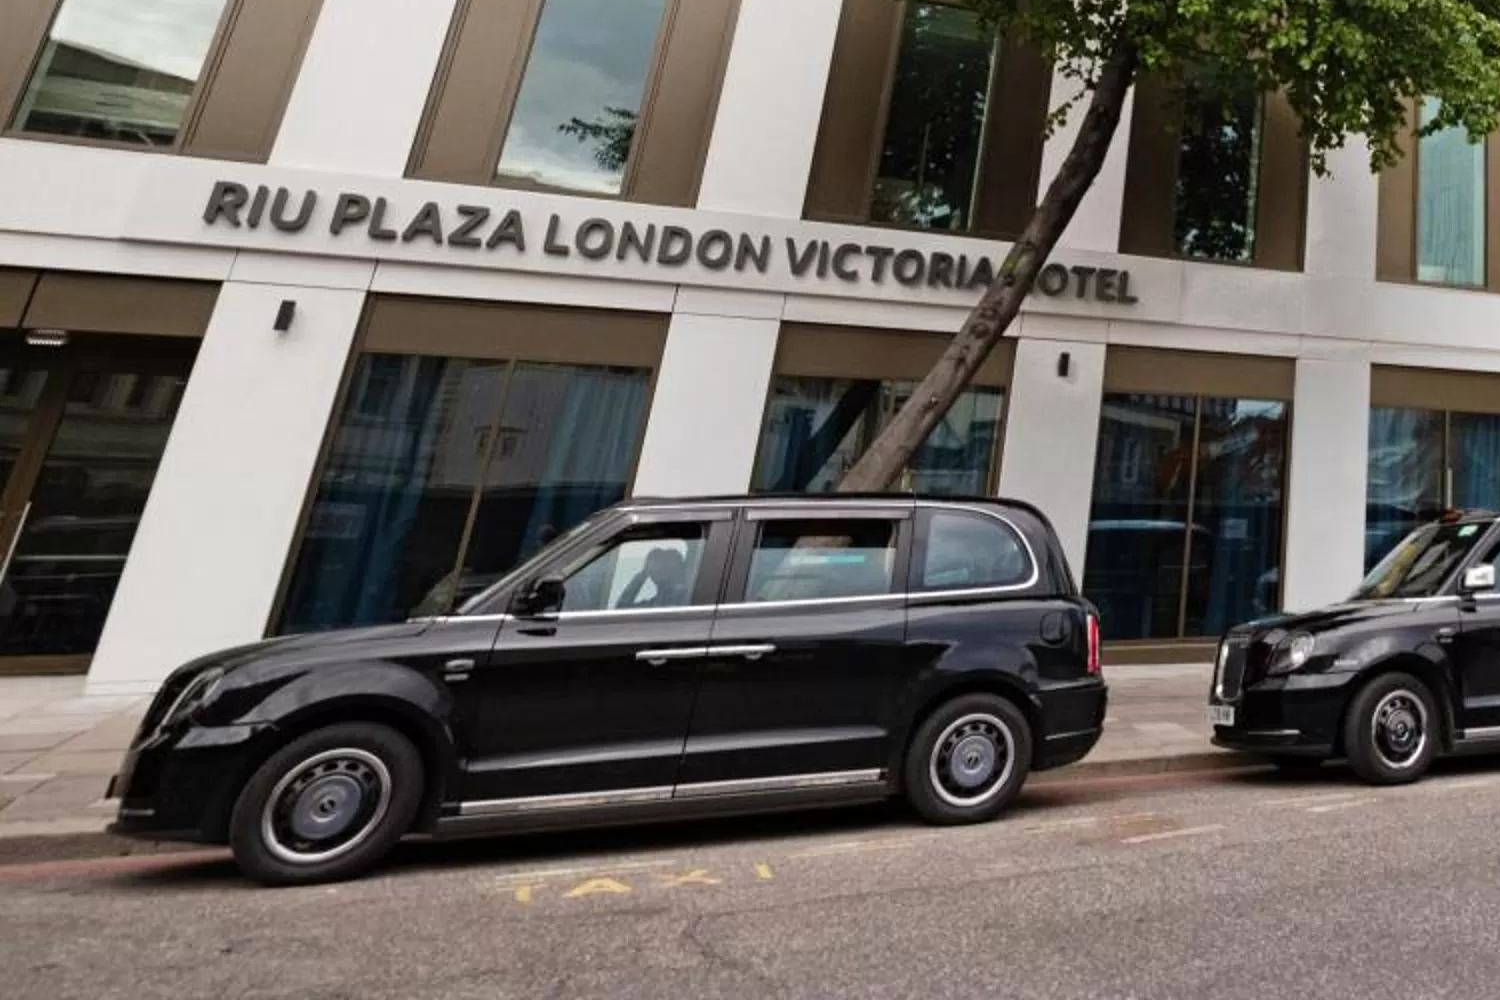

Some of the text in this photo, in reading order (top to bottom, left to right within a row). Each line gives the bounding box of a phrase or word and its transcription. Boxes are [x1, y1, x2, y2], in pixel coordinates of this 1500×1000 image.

[203, 180, 1139, 305] RIU PLAZA LONDON VICTORIA OTEL
